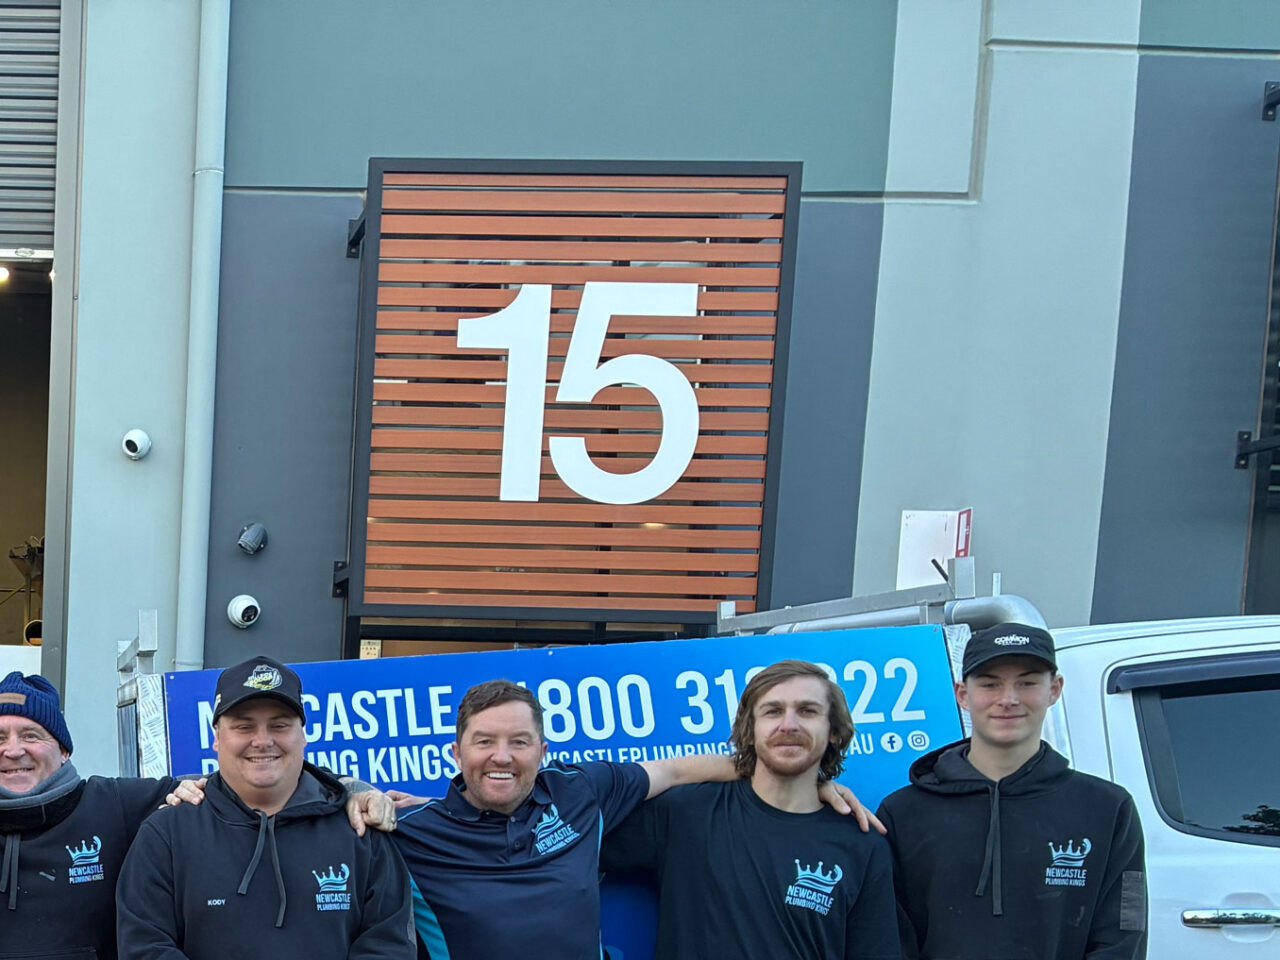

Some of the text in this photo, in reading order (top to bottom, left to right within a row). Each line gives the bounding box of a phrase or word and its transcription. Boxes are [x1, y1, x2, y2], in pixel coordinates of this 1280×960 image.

[457, 281, 700, 505] 15
[516, 657, 927, 743] 800 31 22
[197, 685, 458, 750] NCASTLE
[367, 743, 463, 784] KINGS
[535, 823, 575, 853] NEWCASTLE
[68, 863, 104, 877] NEWCASTLE
[1045, 867, 1088, 879] NEWCASTLE
[316, 893, 351, 903] NEWCASTLE
[787, 884, 835, 909] NEWCASTLE
